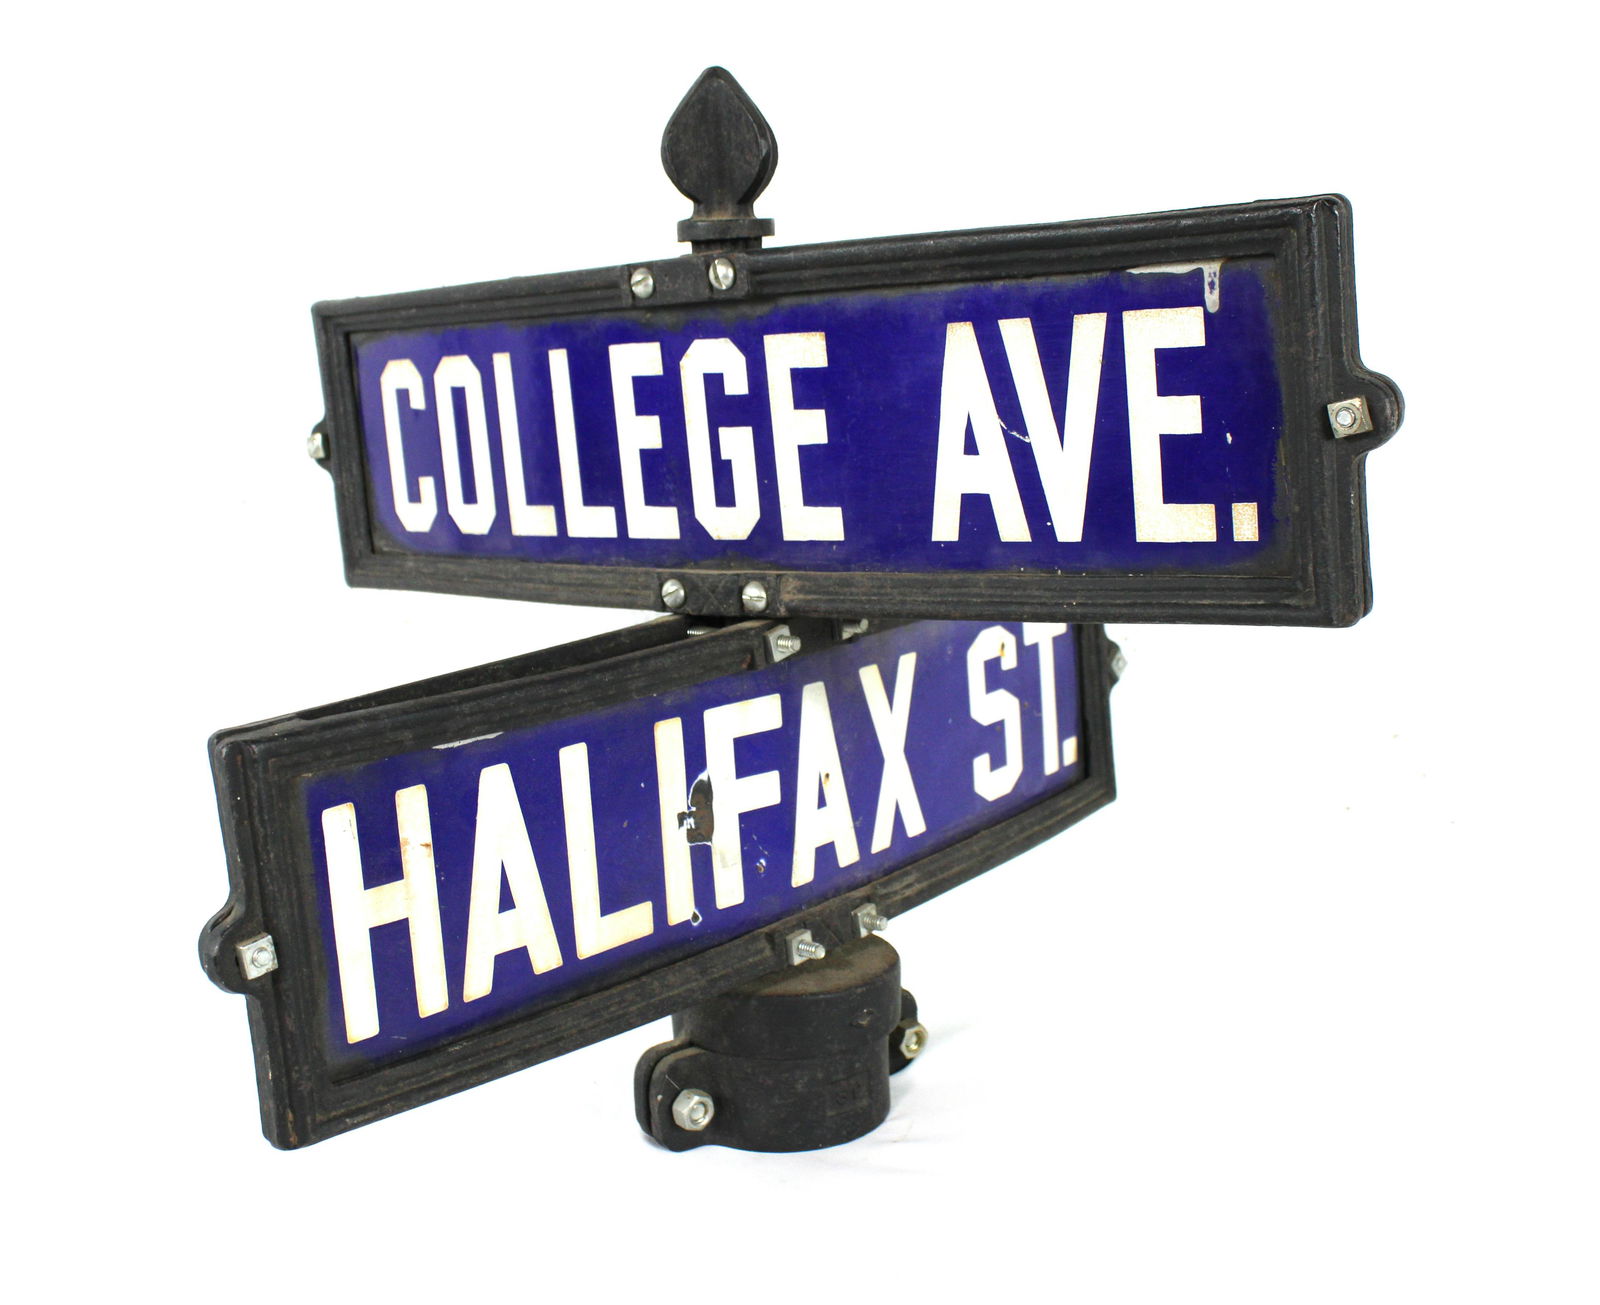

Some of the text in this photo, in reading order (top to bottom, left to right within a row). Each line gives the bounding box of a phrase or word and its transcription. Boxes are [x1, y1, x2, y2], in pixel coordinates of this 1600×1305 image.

[381, 306, 1259, 542] COLLEGE AVE.
[321, 622, 1078, 1044] HALIFAX ST.
